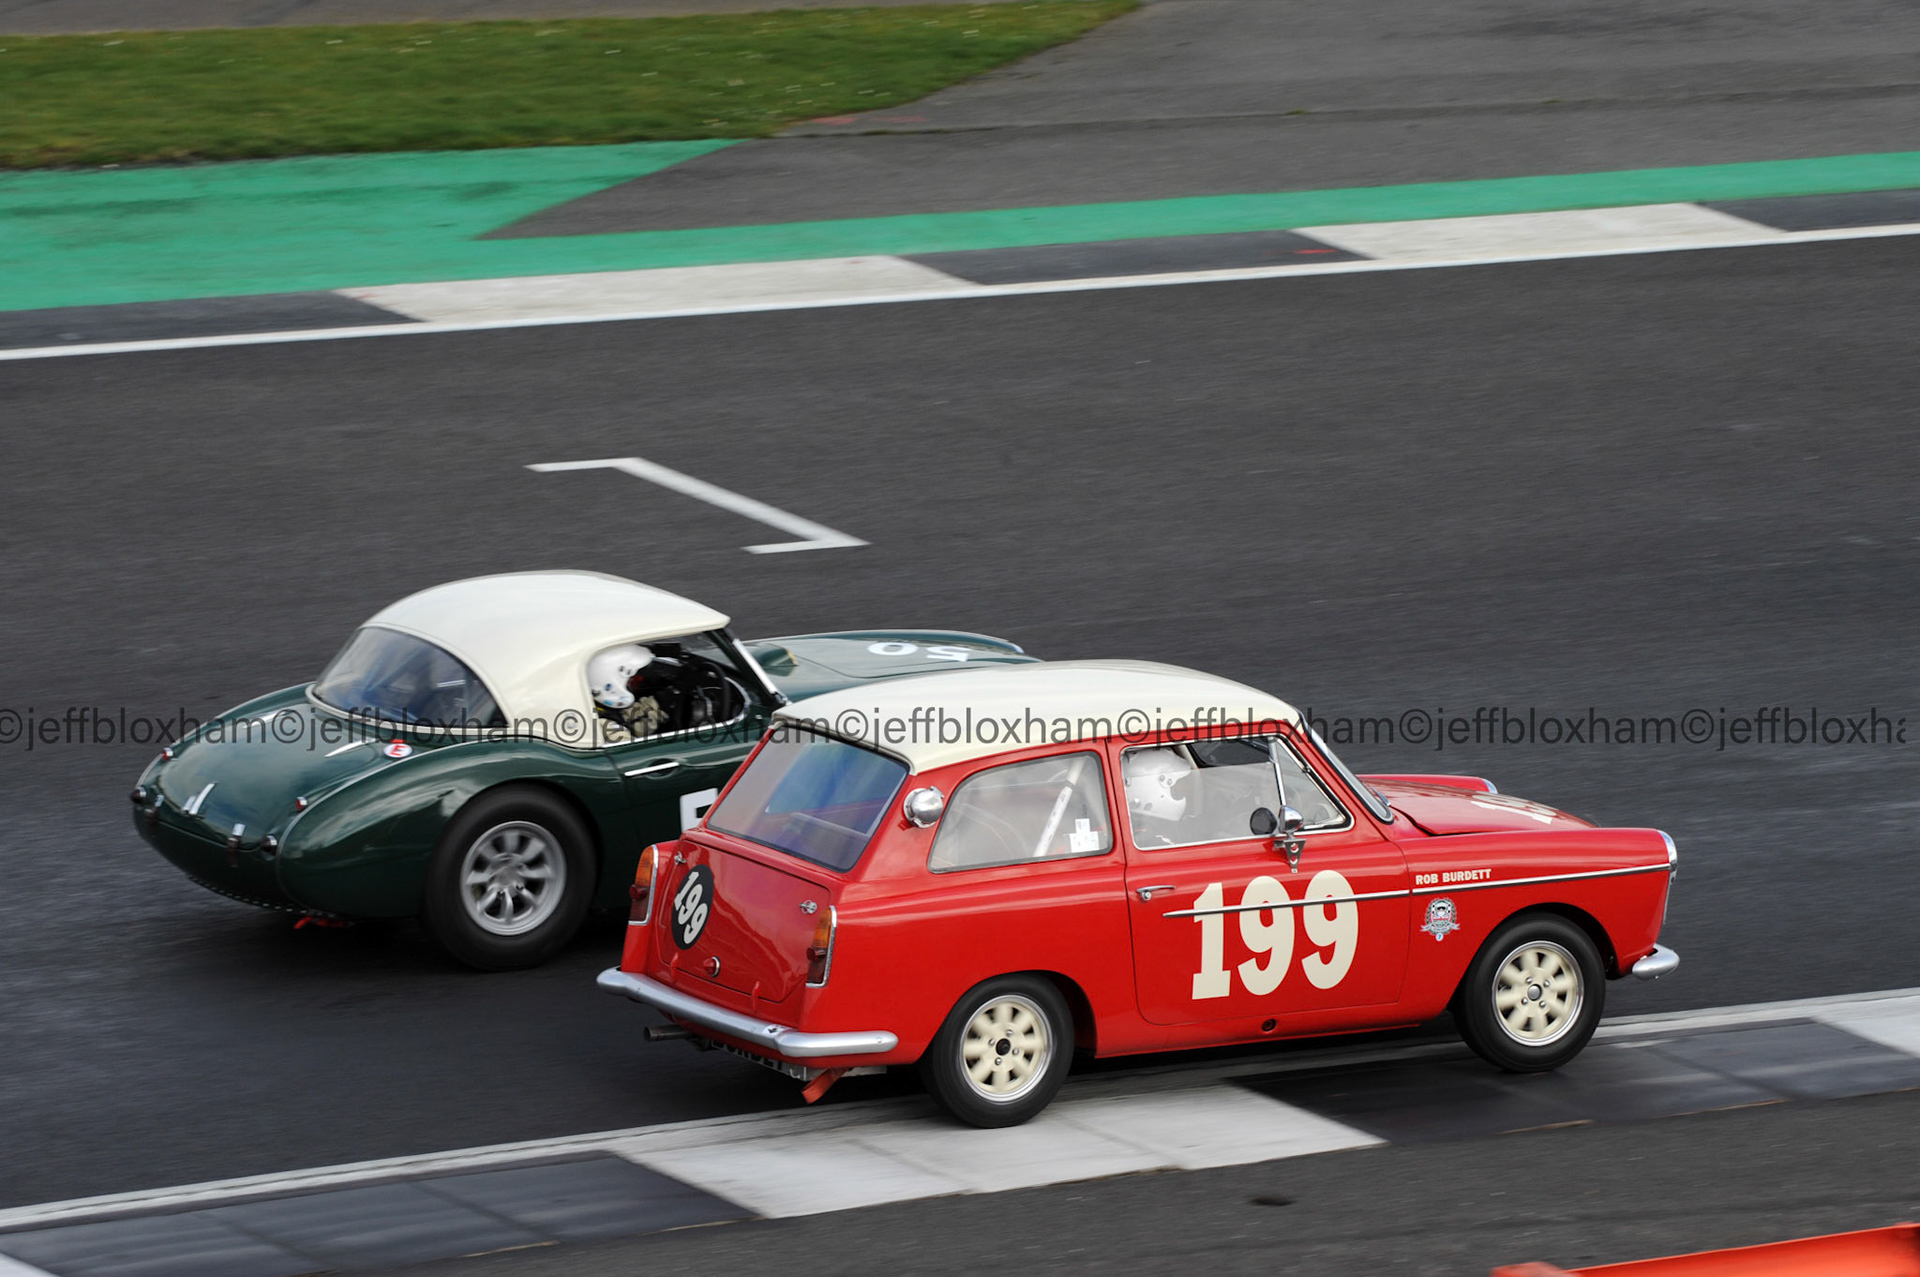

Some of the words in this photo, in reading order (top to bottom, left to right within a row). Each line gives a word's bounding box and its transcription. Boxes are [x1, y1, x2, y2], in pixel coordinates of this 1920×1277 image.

[674, 871, 709, 945] 199
[1415, 873, 1439, 886] ROB
[1442, 868, 1492, 883] BURDETT
[1192, 869, 1359, 1000] 199
